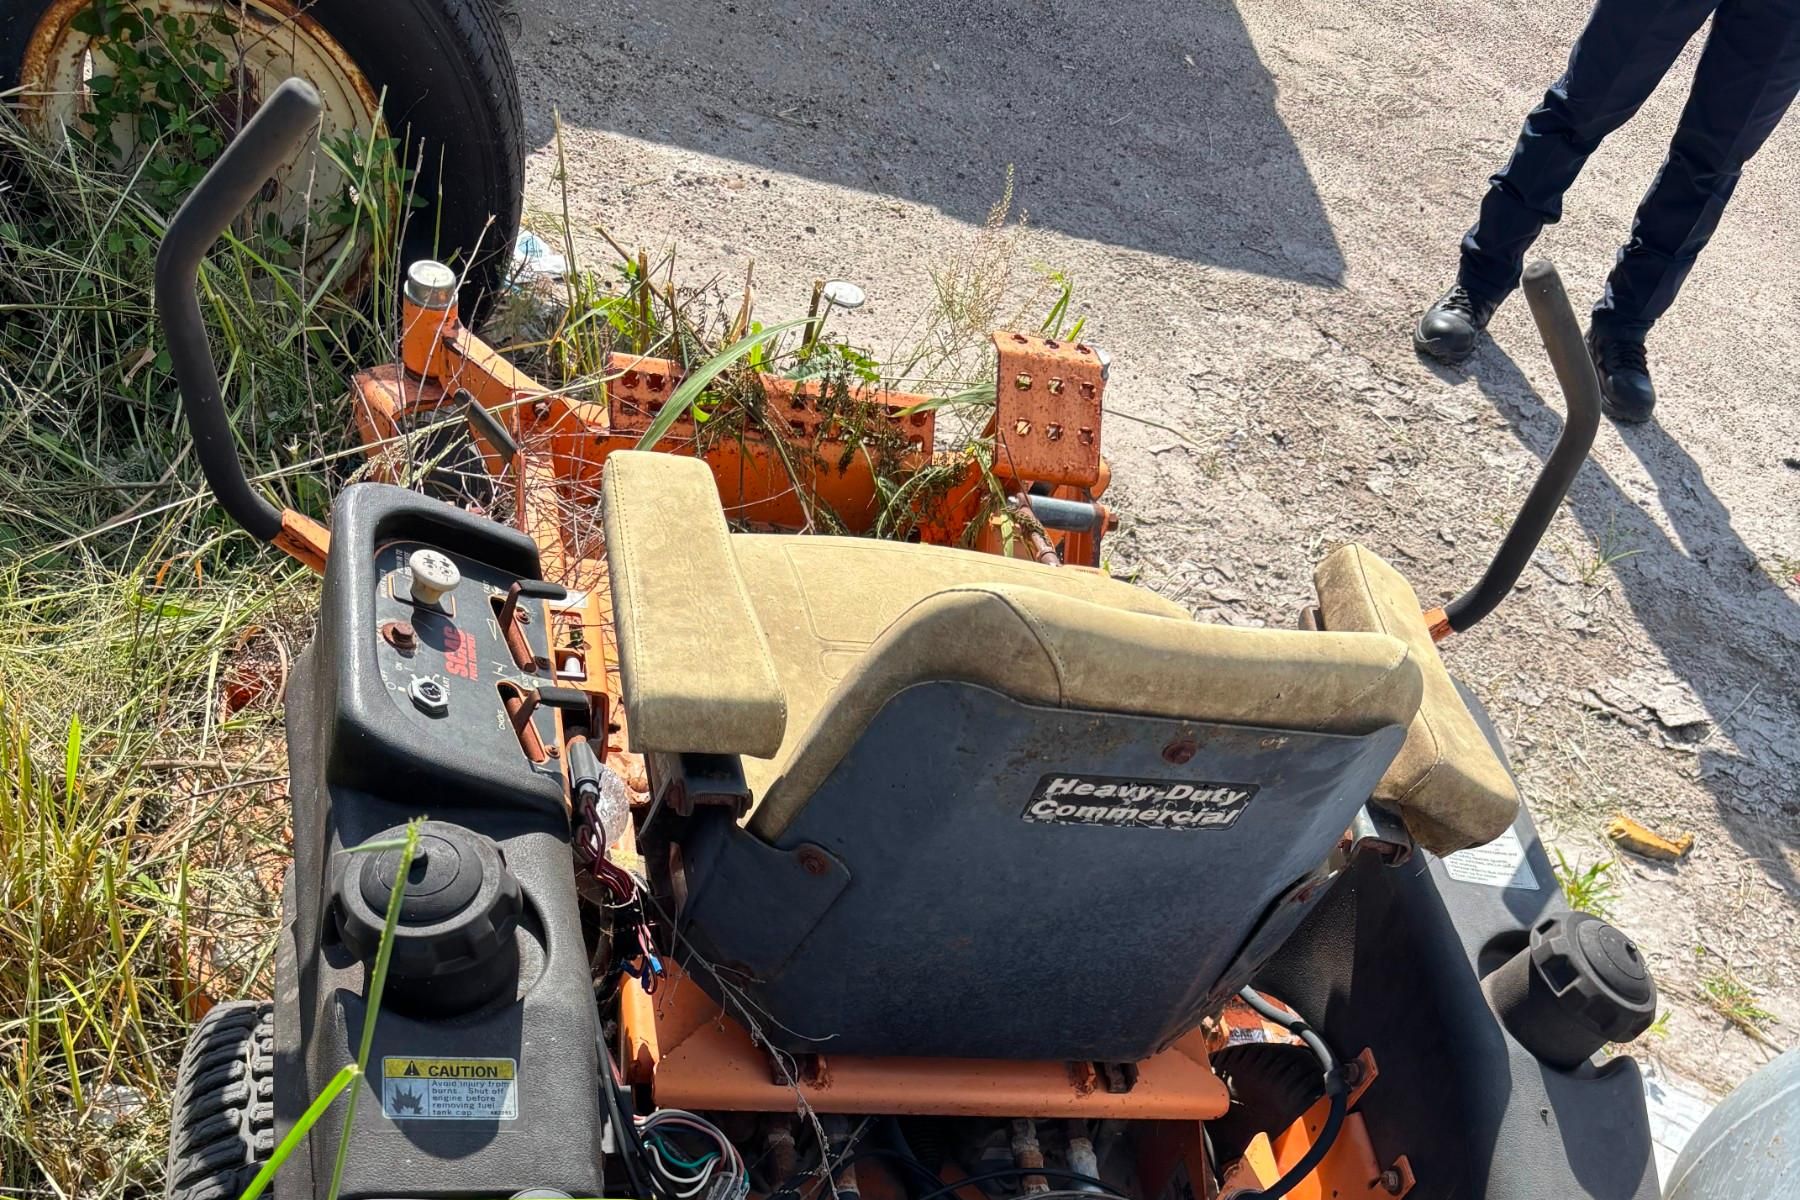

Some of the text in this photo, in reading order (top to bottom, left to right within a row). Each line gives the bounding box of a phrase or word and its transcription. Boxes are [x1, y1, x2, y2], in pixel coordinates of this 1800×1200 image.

[443, 625, 468, 678] SCAG
[1046, 778, 1249, 805] Heavy-Duty
[1031, 800, 1239, 825] Commercial
[428, 1065, 498, 1078] CAUTION
[460, 1081, 485, 1089] injury
